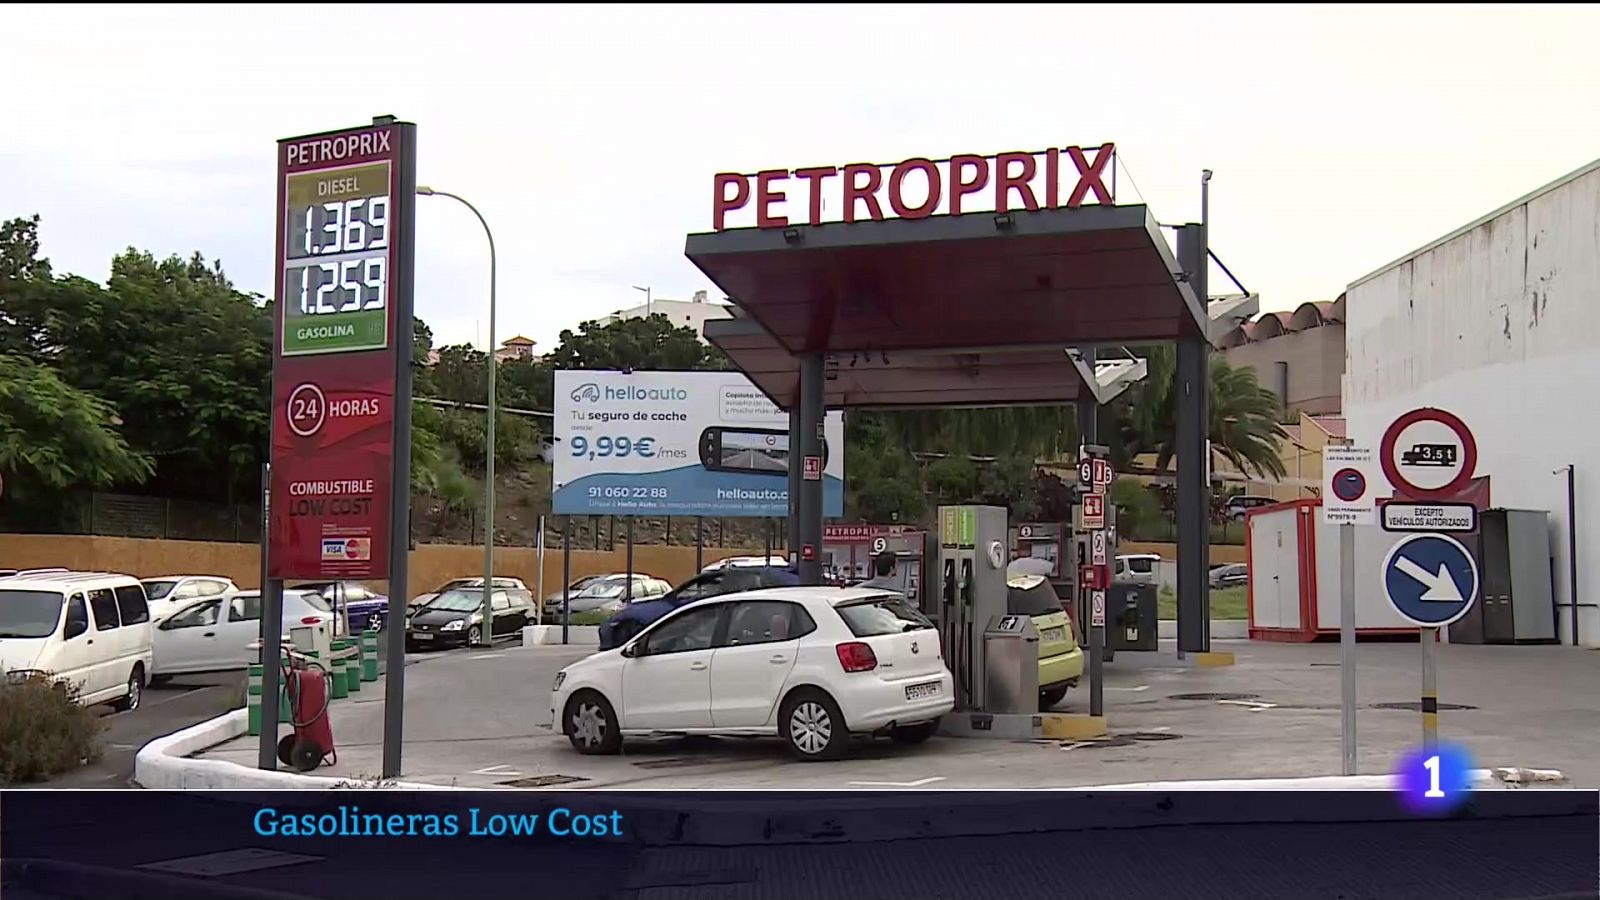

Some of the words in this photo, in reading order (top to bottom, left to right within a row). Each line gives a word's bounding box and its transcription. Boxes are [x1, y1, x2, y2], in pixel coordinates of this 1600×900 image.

[287, 130, 391, 166] PETROPRIX
[318, 178, 360, 196] DIESEL
[712, 142, 1116, 231] PETROPRIX
[304, 196, 390, 255] 1.369
[301, 257, 386, 314] 1.259
[297, 324, 354, 340] GASOLINA
[294, 398, 318, 420] 24
[329, 399, 379, 418] HORAS
[570, 411, 585, 420] Tu
[588, 411, 630, 423] seguro
[633, 411, 648, 421] de
[651, 411, 687, 421] coche
[1422, 447, 1443, 460] 3,5
[1446, 448, 1453, 460] t
[289, 479, 374, 496] COMBUSTIBLE
[588, 487, 601, 498] 91
[605, 487, 630, 498] 060
[632, 487, 648, 498] 22
[650, 488, 667, 498] 88
[717, 488, 788, 500] helloauto.c
[288, 499, 325, 517] LOW
[329, 498, 372, 516] COST
[1414, 508, 1444, 517] EXCEPTO
[1425, 517, 1470, 527] AUTORIZADOS
[325, 545, 342, 554] VISA
